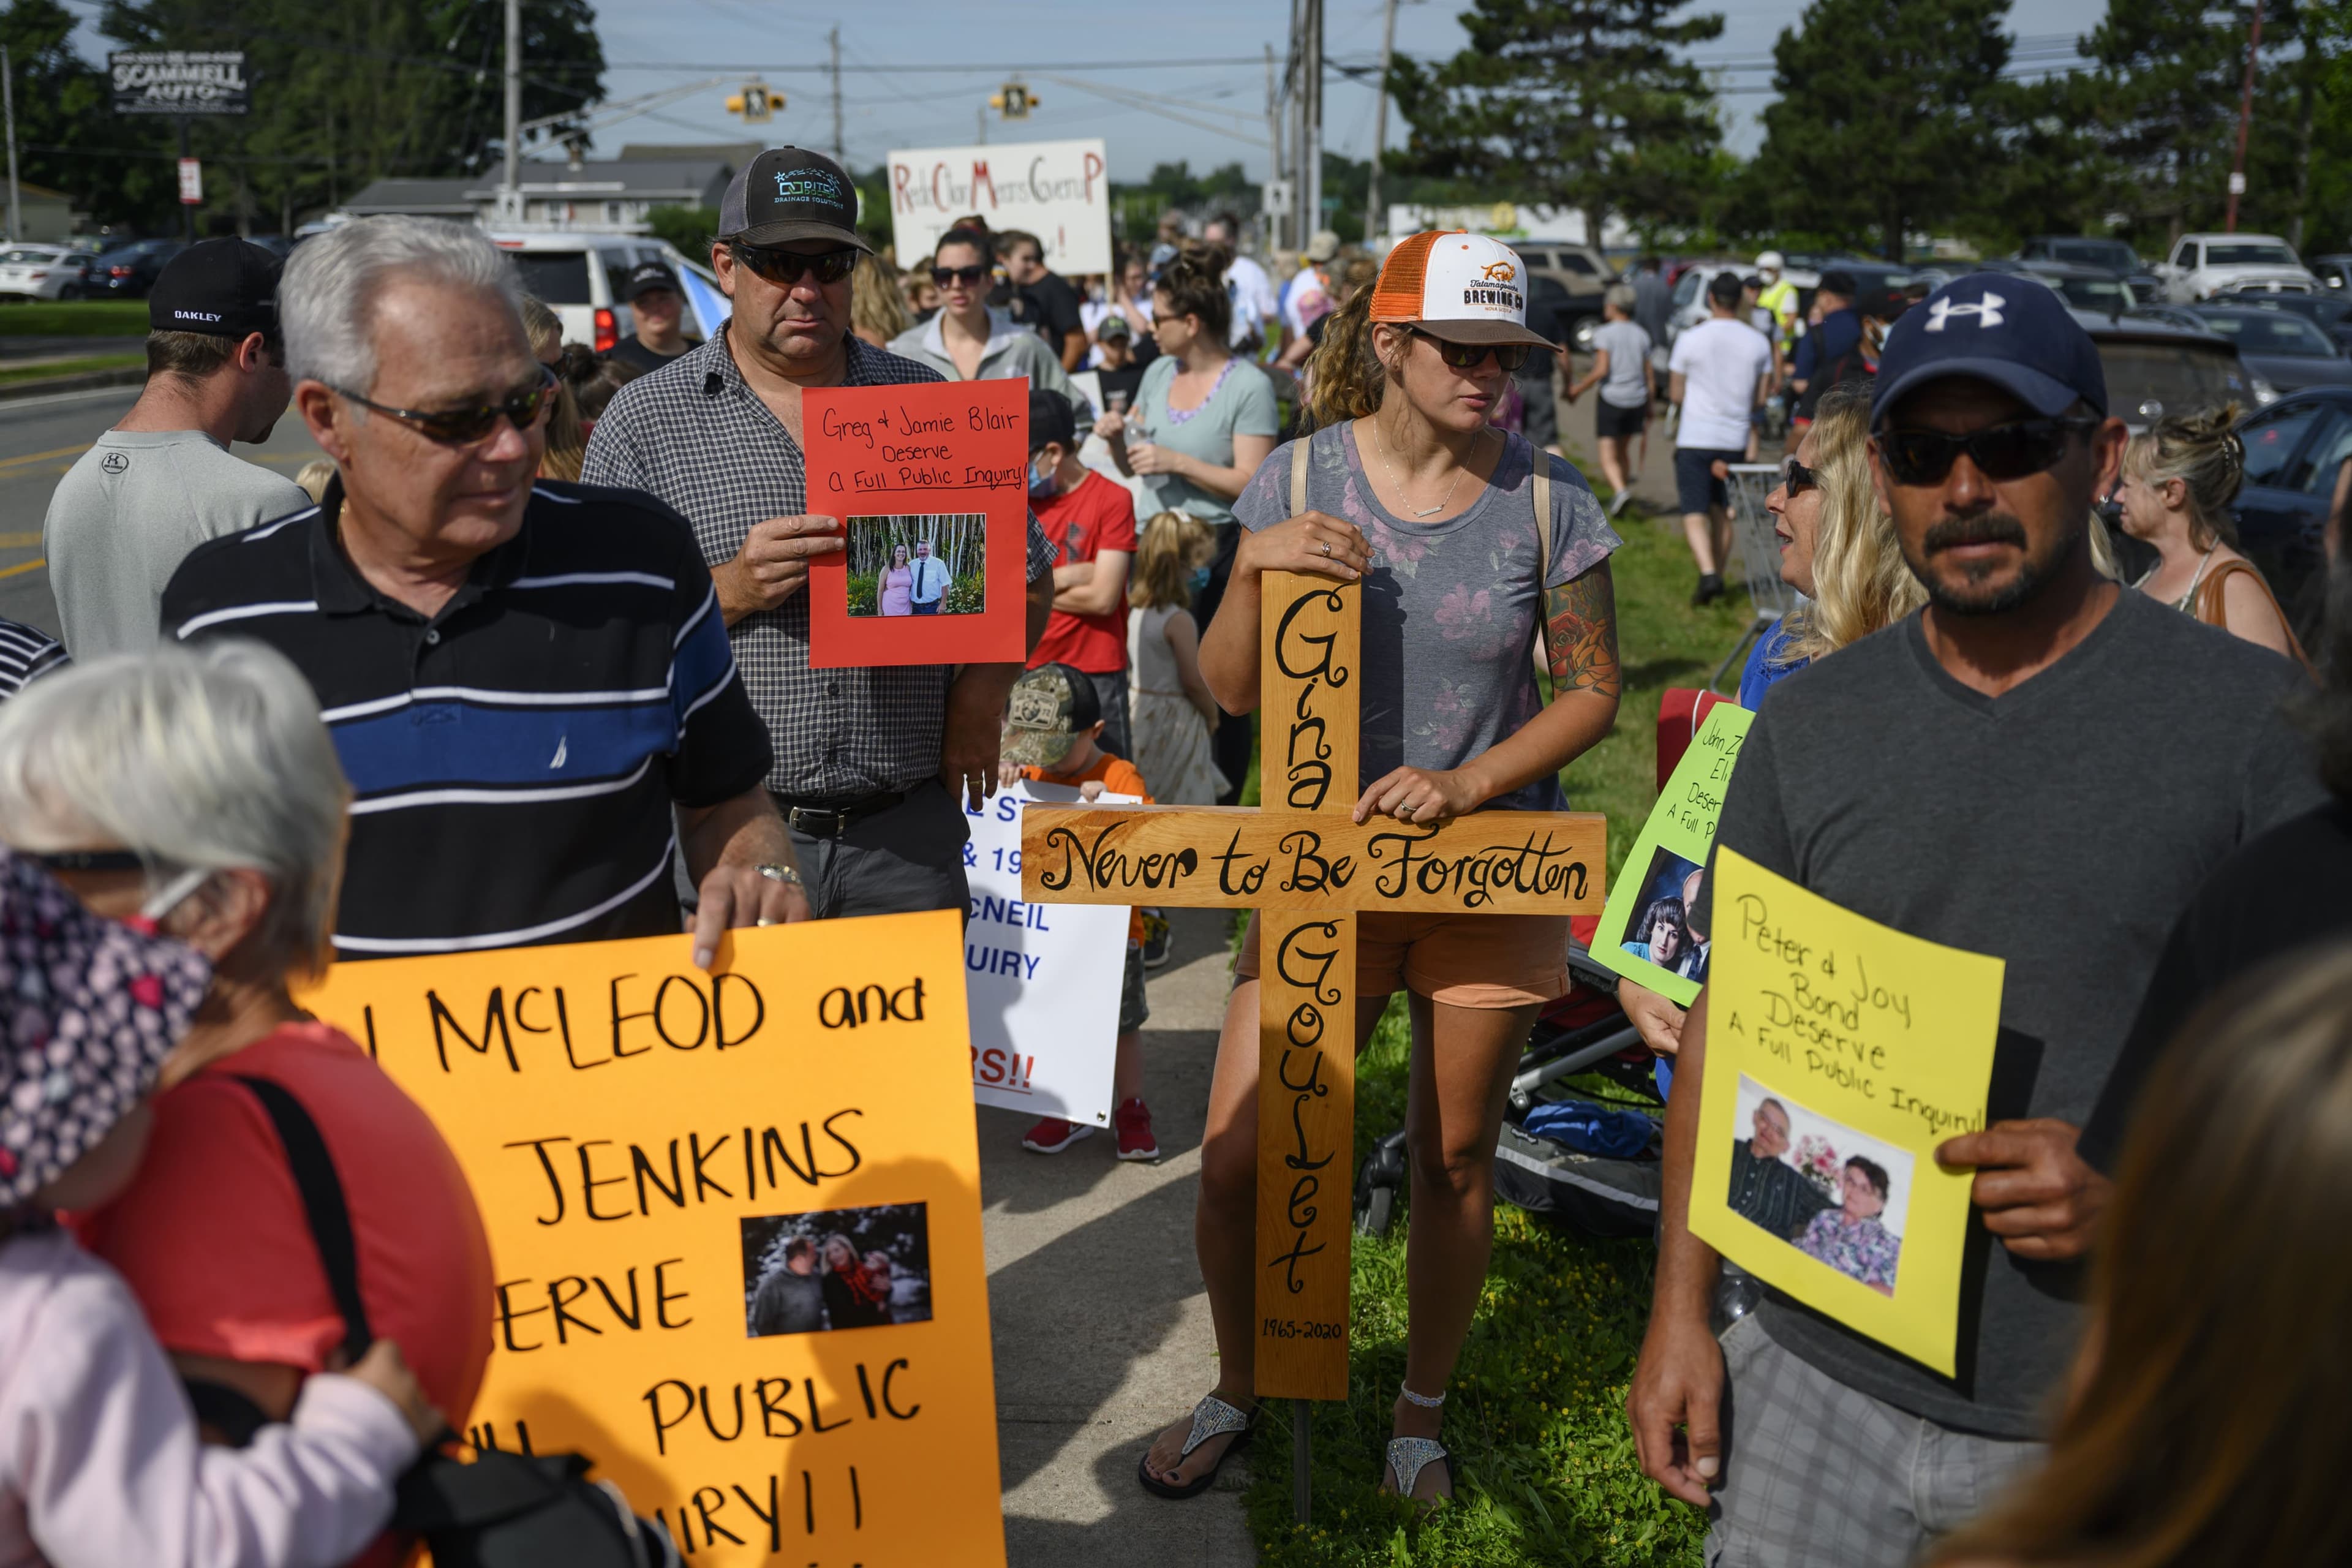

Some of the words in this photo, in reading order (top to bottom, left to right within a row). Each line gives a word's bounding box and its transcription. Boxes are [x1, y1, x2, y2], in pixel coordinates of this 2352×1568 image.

[113, 64, 247, 91] SCAMMELL
[146, 83, 216, 100] AUTO
[804, 181, 835, 193] DITCH
[812, 197, 843, 209] SOLUTIONS
[1464, 290, 1512, 306] BREWING
[175, 310, 222, 322] OAKLEY
[823, 408, 874, 449] Greg
[900, 405, 955, 436] Jamie
[968, 406, 1020, 431] Blair
[883, 445, 952, 462] Deserve
[854, 470, 887, 489] Full
[899, 467, 952, 486] Public
[963, 462, 1028, 491] Inquiry!
[1275, 582, 1356, 810] Gina
[1703, 718, 1725, 752] John
[1667, 803, 1676, 819] A
[1681, 810, 1698, 834] Full
[1041, 819, 1199, 892] Never
[1211, 827, 1270, 895] to
[1279, 829, 1357, 897] Be
[1367, 823, 1588, 908] Forgotten
[967, 944, 1041, 980] UIRY
[1736, 894, 1812, 967] Peter
[1850, 953, 1912, 1030] Joy
[818, 976, 926, 1030] and
[1790, 972, 1860, 1031] Bond
[1760, 989, 1887, 1071] Deserve
[1728, 1011, 1745, 1036] A
[1757, 1027, 1792, 1065] Full
[1805, 1049, 1875, 1099] Public
[502, 1108, 864, 1226] JENKINS
[1262, 1317, 1342, 1340] 1965-2020
[642, 1358, 922, 1455] PUBLIC
